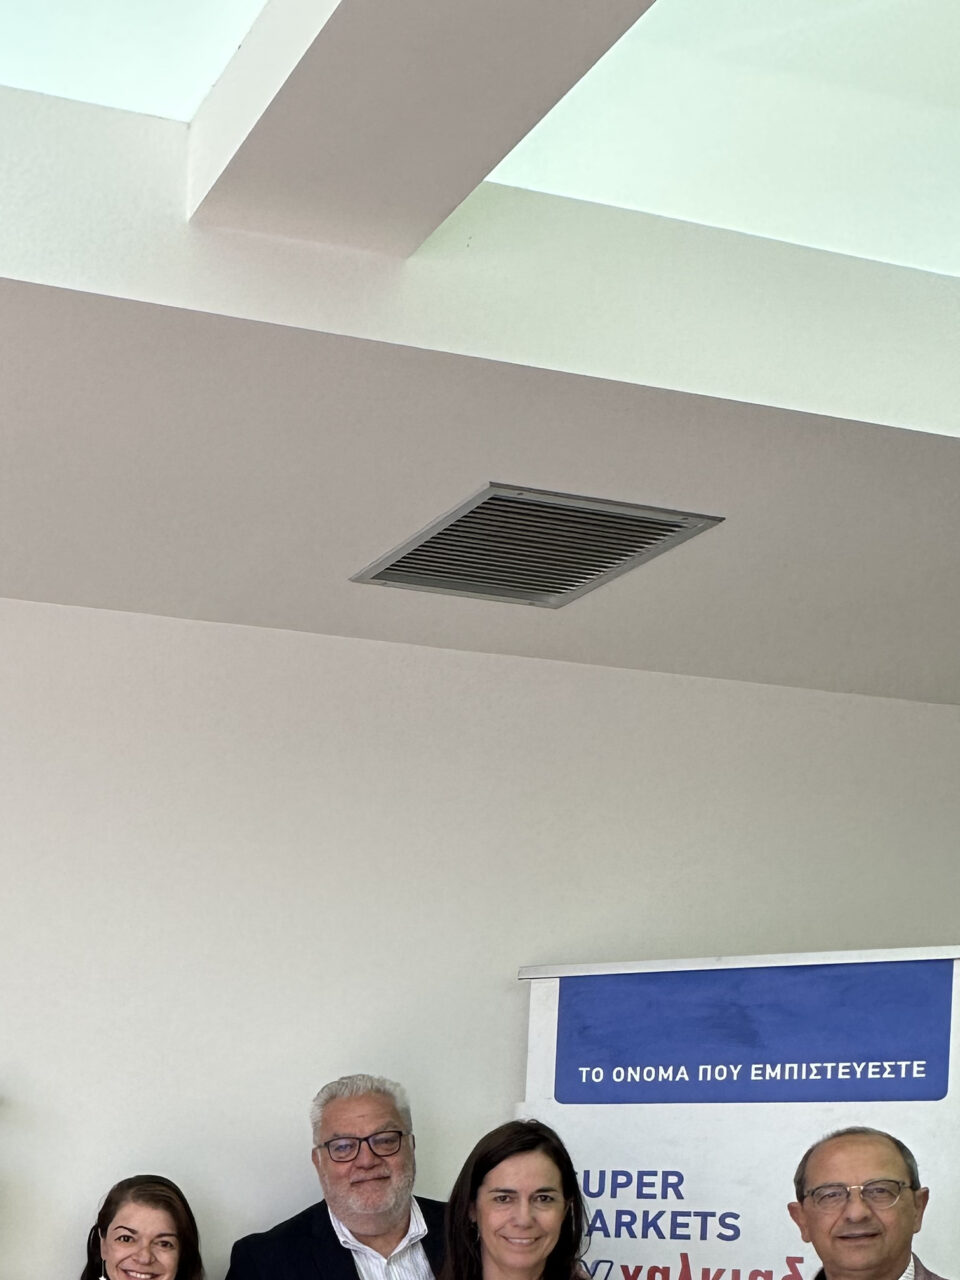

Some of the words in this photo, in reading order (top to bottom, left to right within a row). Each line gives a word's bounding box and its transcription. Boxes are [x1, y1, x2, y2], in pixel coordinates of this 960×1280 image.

[578, 1067, 604, 1083] ΤΟ
[612, 1065, 690, 1083] ΟΝΟΜΑ
[698, 1064, 742, 1082] ΠΟΥ
[750, 1060, 928, 1081] ΕΜΠΙΣΤΕΥΕΣΤΕ
[582, 1169, 685, 1200] UPER
[585, 1208, 741, 1242] ARKETS
